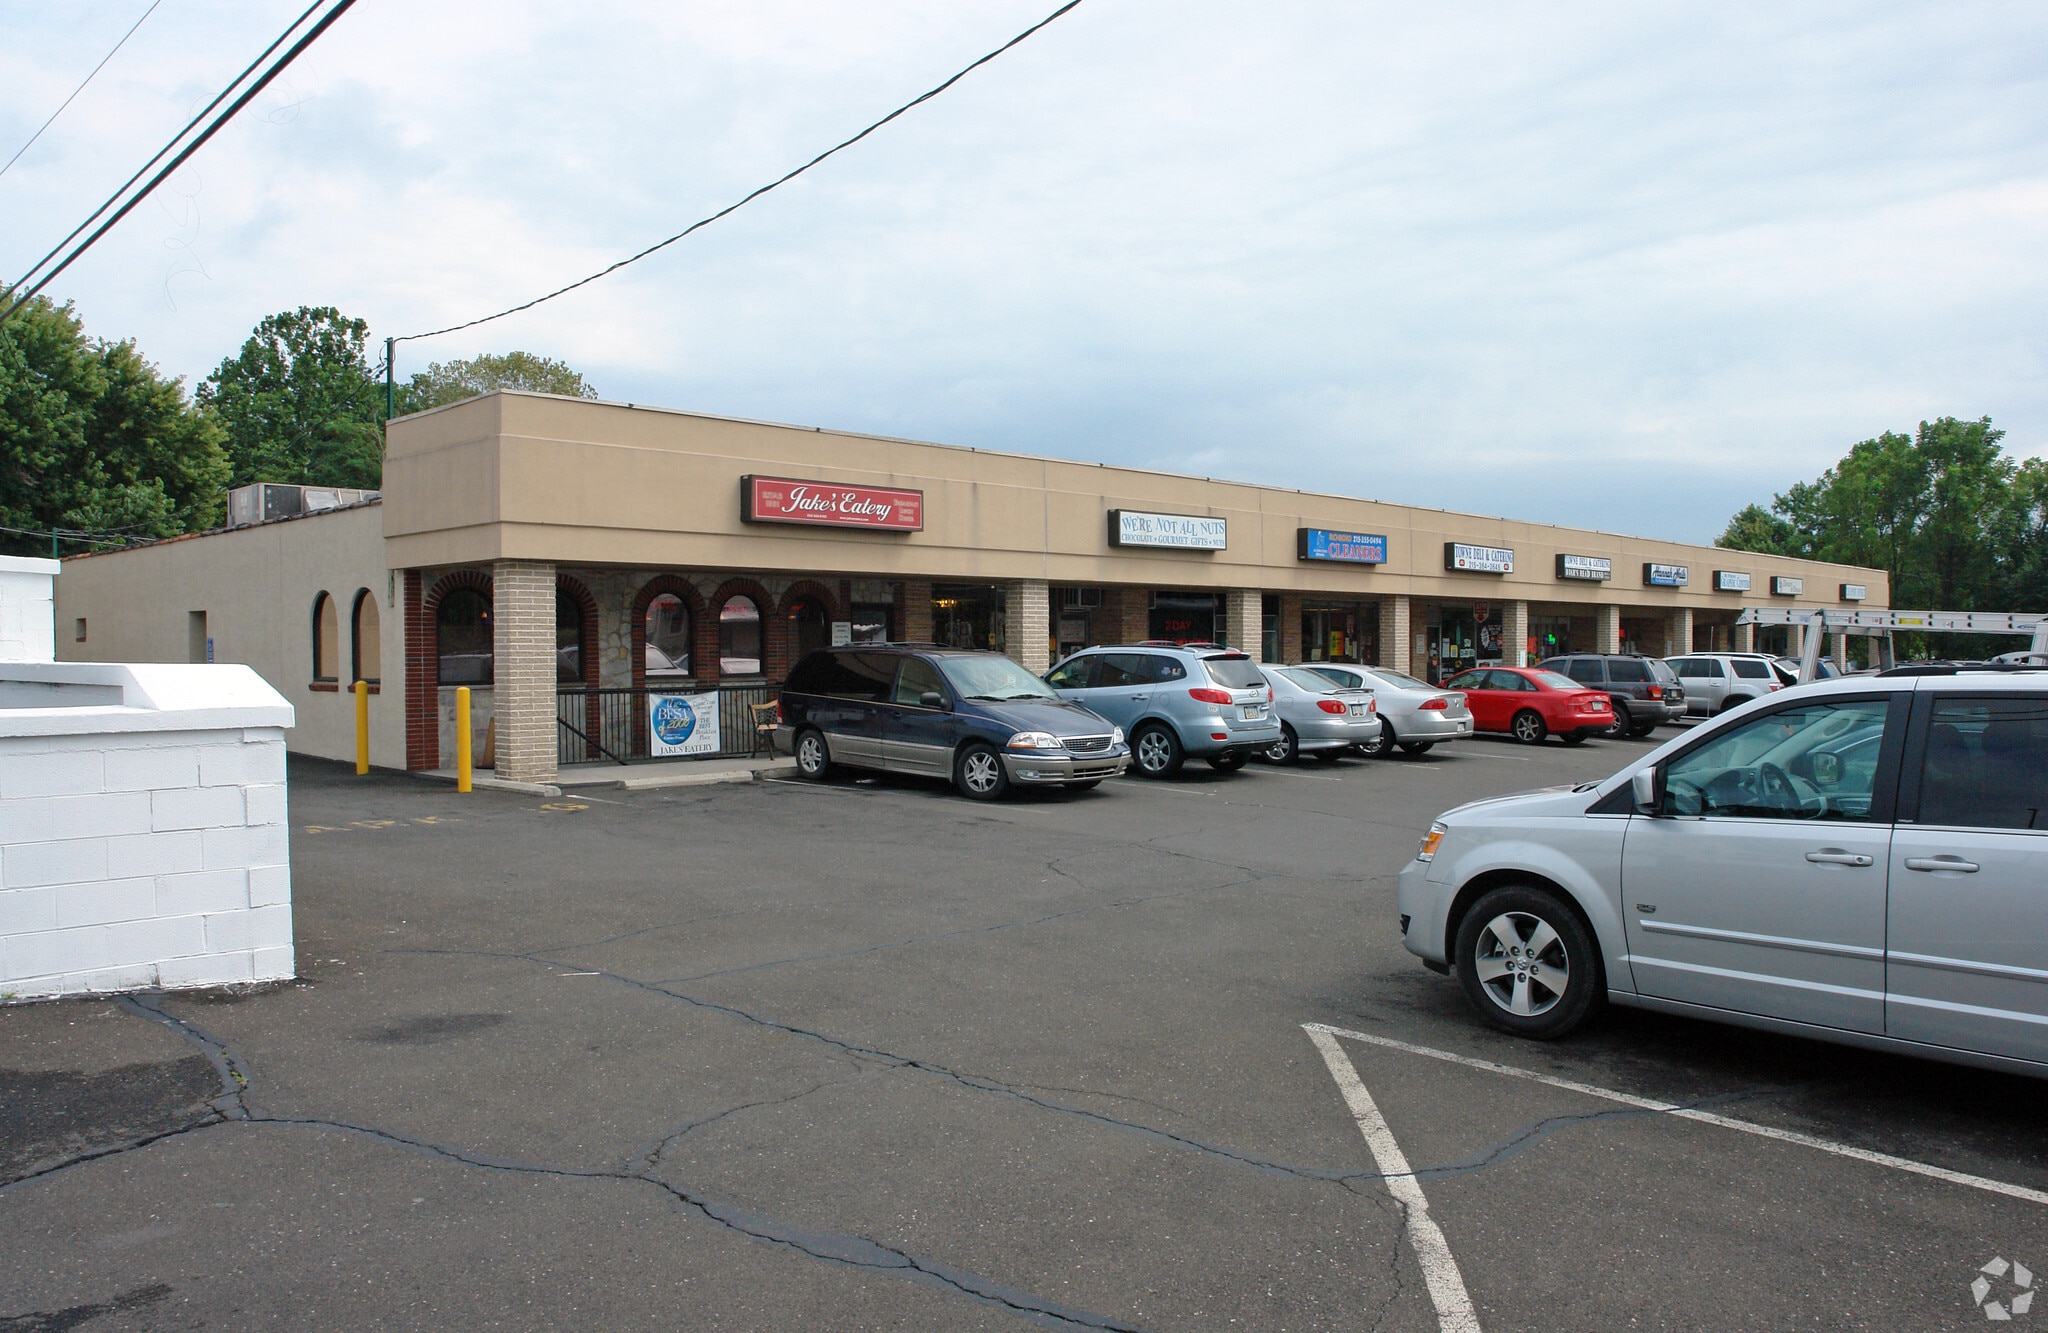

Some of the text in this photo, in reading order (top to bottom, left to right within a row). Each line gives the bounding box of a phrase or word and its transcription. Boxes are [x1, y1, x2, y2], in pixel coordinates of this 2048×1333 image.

[781, 486, 893, 522] Jake's Eatery
[1121, 516, 1225, 537] WE'RE NOT ALL NUTS
[1121, 533, 1225, 547] CHOCOLATE GOURMET GIFTS NUTS
[1327, 542, 1382, 561] CLEANERS
[1455, 545, 1472, 559] TOWNE
[1473, 547, 1485, 560] DELI
[1491, 550, 1513, 563] CATERING
[1172, 619, 1192, 631] DAY
[658, 707, 690, 720] BEST
[684, 743, 713, 754] EATERY
